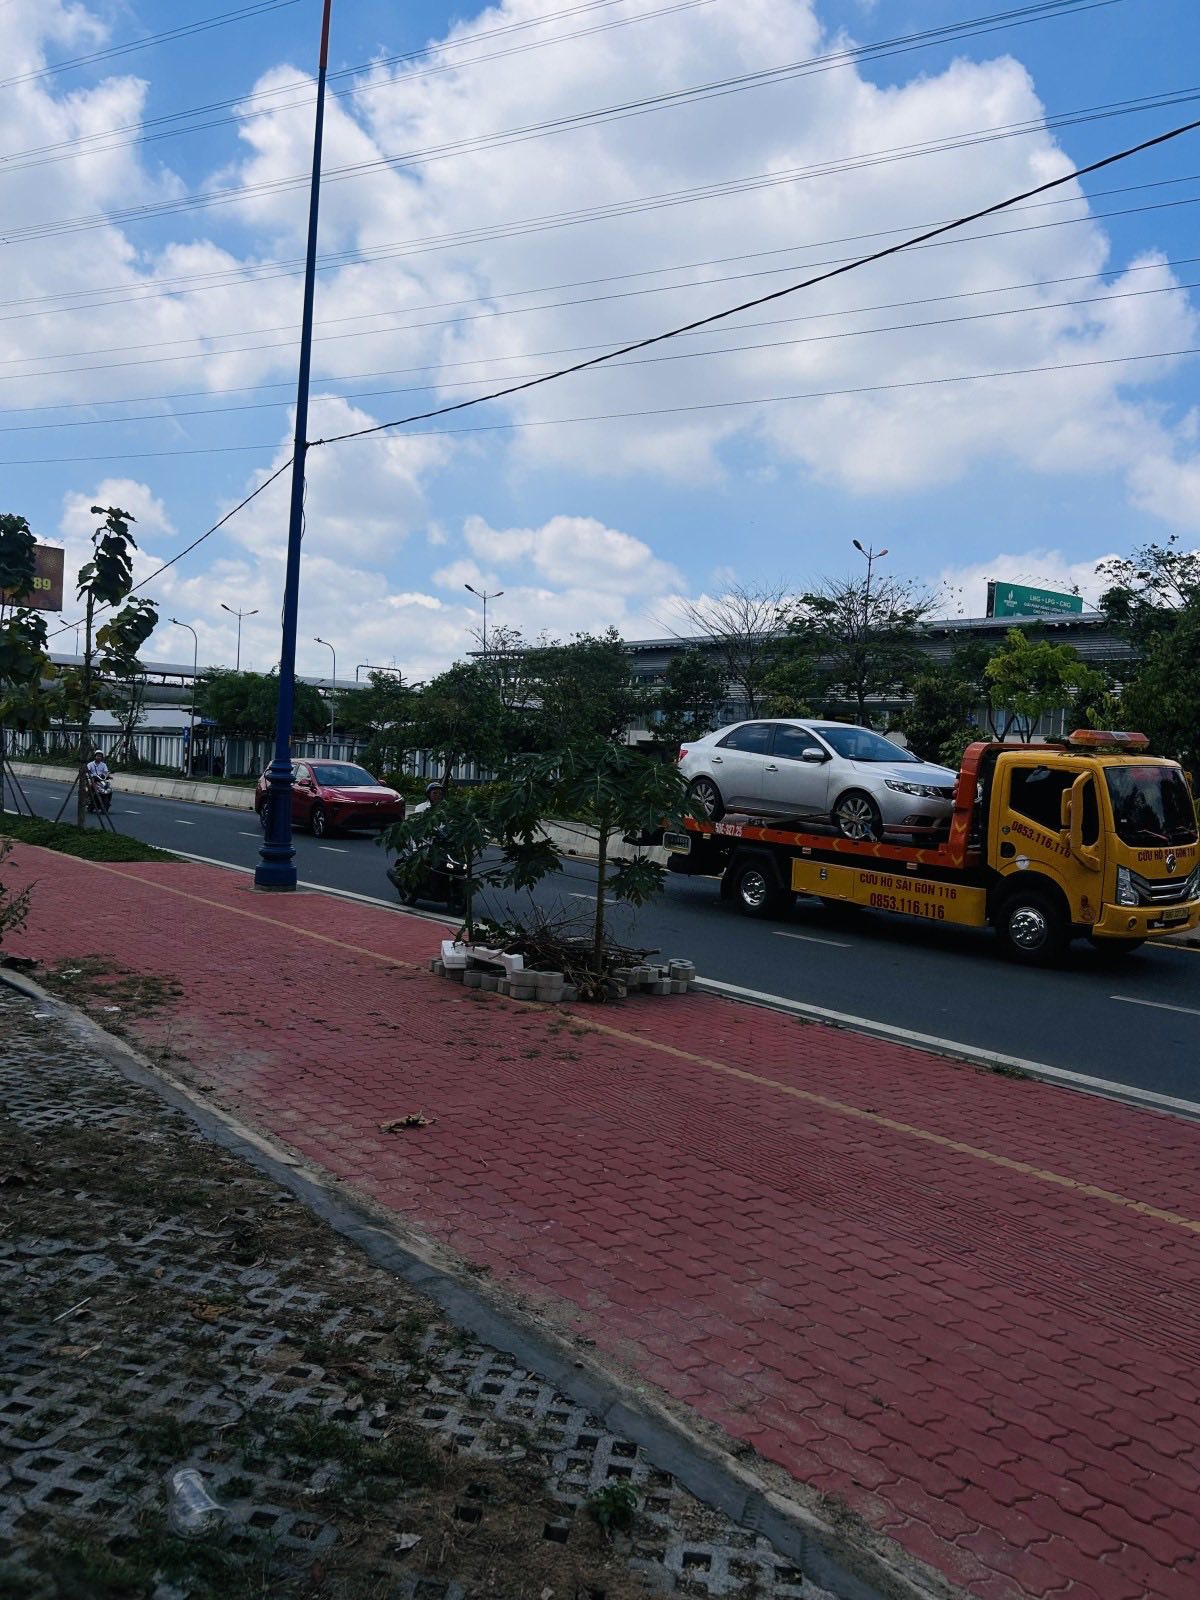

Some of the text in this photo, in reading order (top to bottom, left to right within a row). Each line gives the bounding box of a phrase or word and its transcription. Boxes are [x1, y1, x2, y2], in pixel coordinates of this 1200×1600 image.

[860, 872, 956, 899] CỨU HỘ SÀI GÒN 116
[870, 892, 944, 918] 0853.116.116
